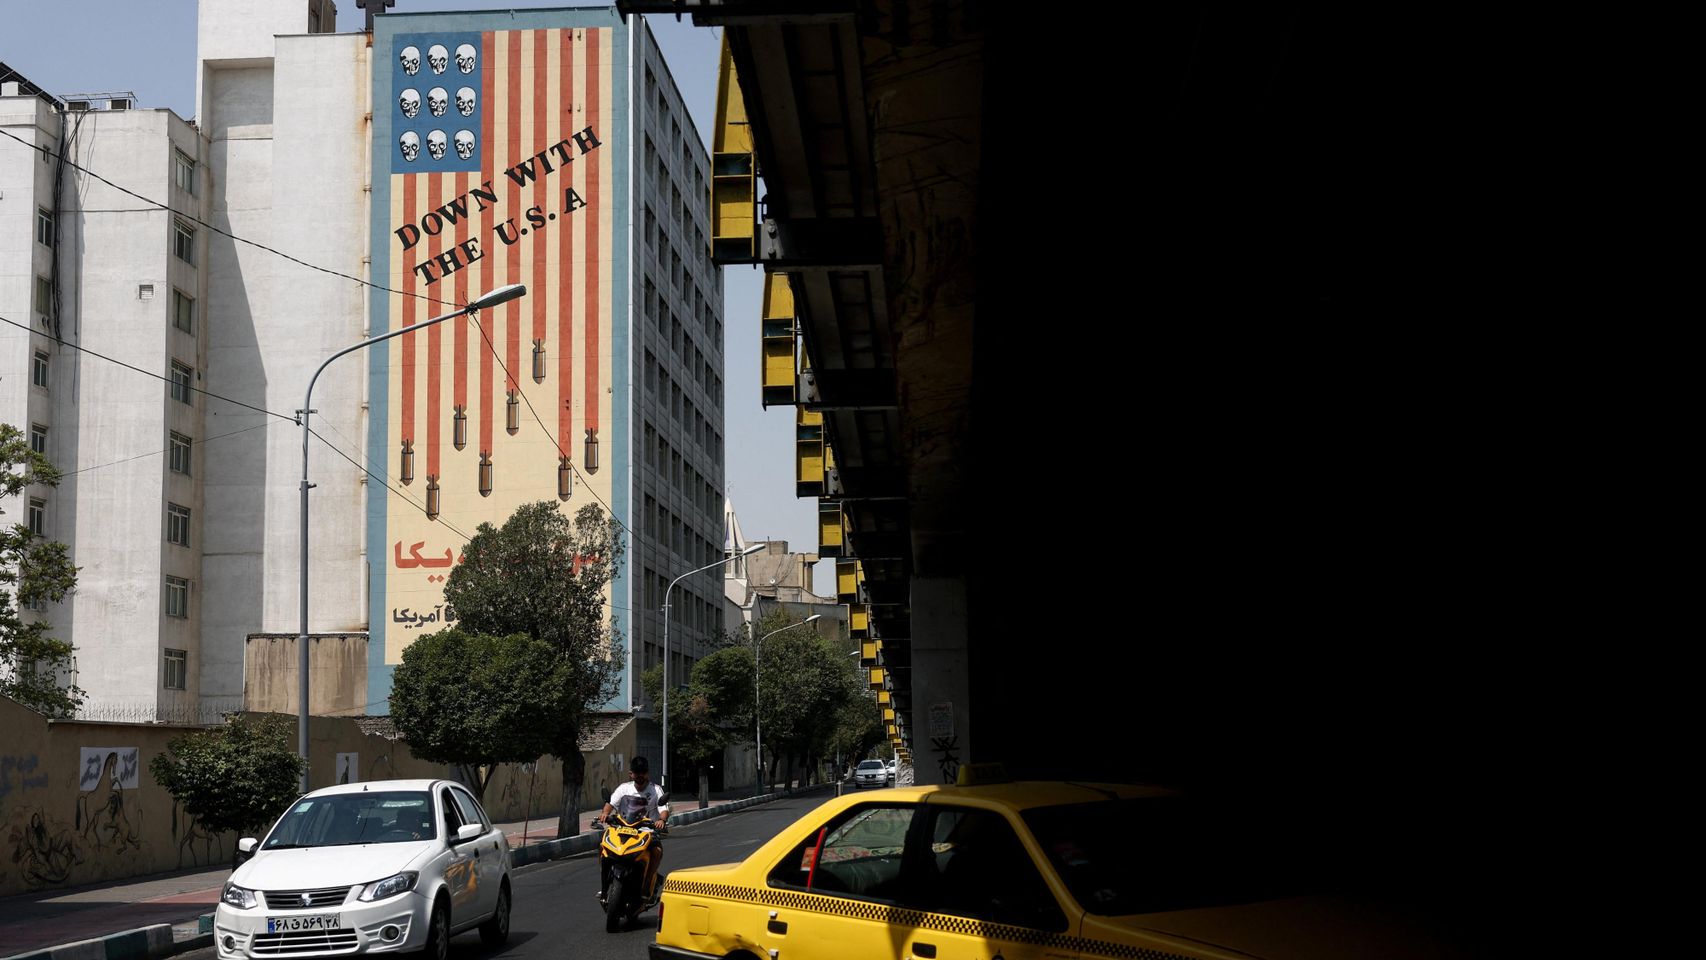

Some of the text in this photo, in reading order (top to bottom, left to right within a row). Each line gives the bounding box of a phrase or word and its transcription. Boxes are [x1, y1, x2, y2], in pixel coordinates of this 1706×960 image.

[394, 126, 602, 251] DOWN WITH
[413, 237, 485, 286] THE
[393, 604, 444, 628] آمریکا
